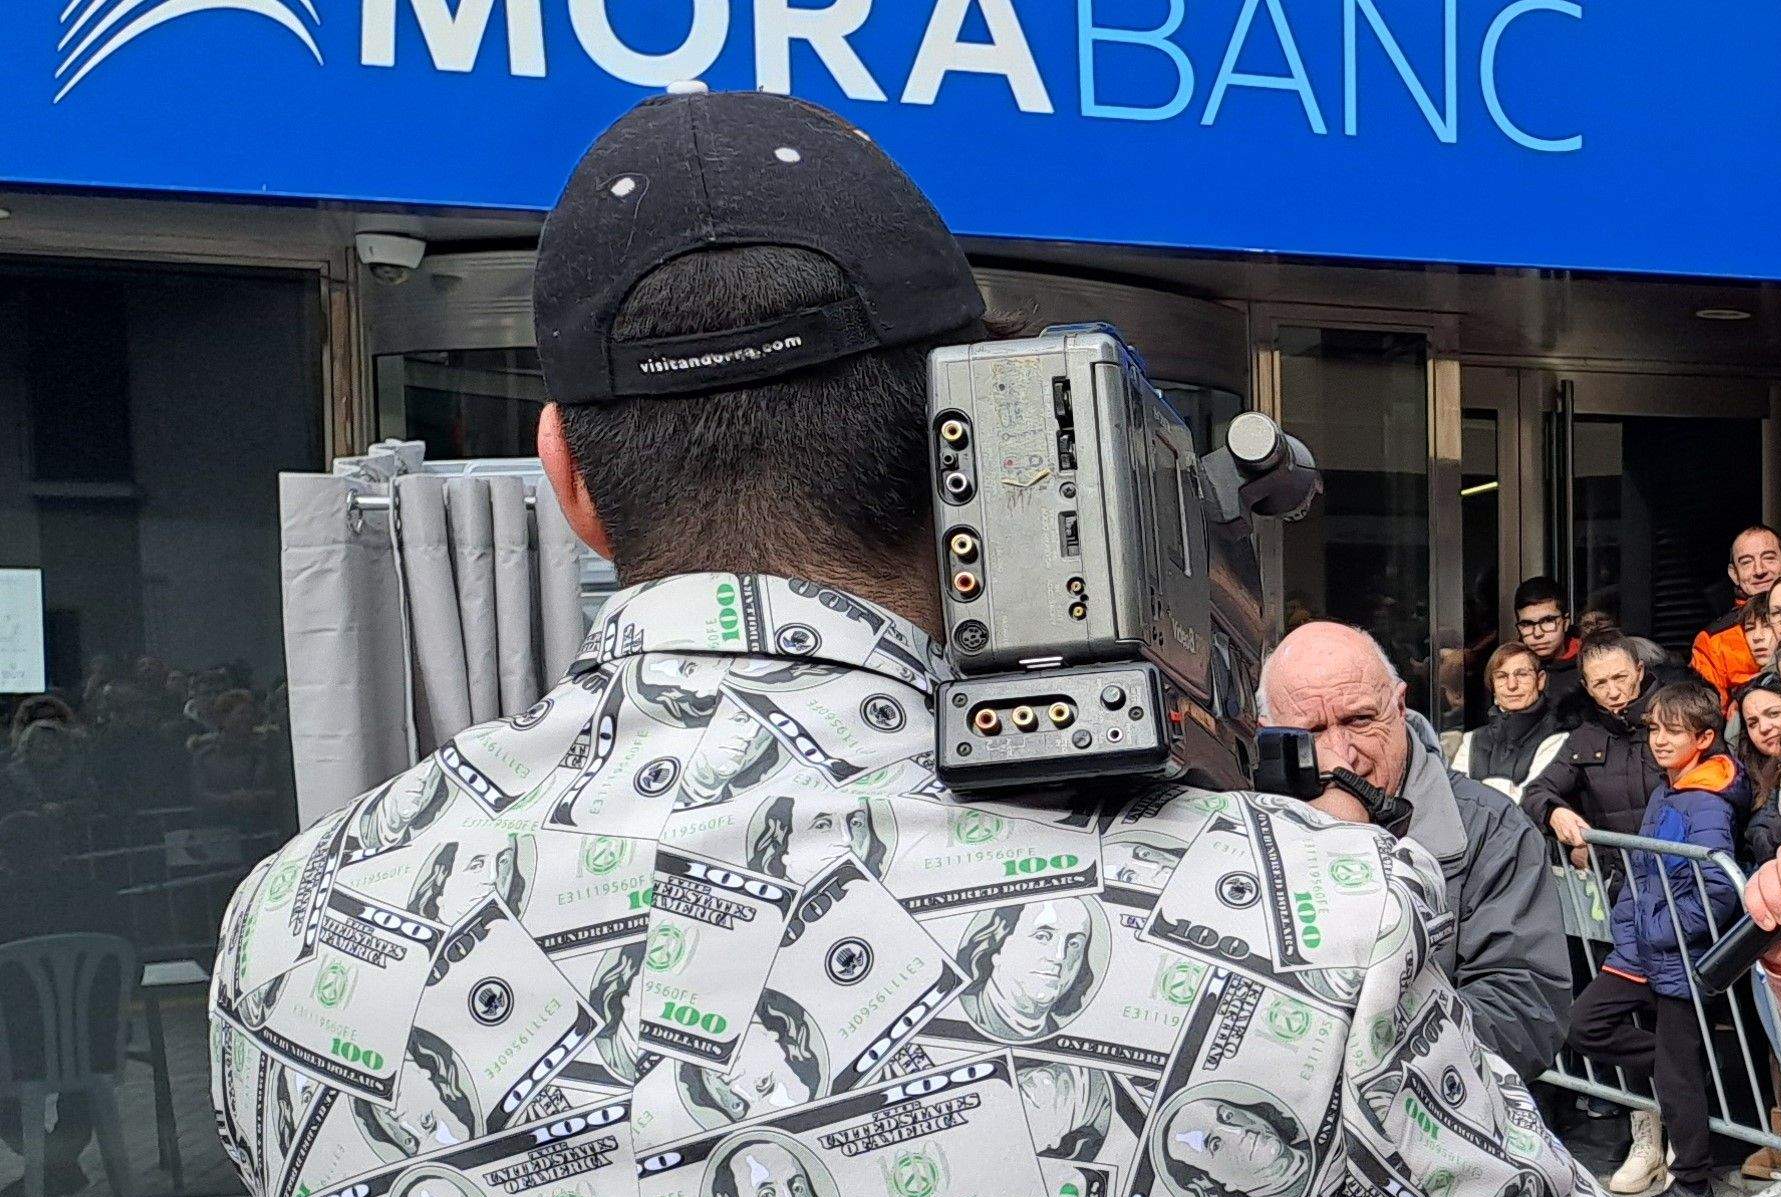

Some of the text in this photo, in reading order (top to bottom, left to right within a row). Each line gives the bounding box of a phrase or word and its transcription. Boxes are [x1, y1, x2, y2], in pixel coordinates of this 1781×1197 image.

[716, 583, 739, 640] 100
[787, 574, 864, 622] 100
[924, 845, 1036, 869] E31119560FE
[1004, 853, 1078, 875] 100
[685, 859, 786, 903] 100
[908, 872, 1086, 910] HUNDRED DOLLARS
[1261, 834, 1282, 889] HUNDRED
[1273, 890, 1296, 956] DOLLARS
[358, 905, 435, 942] 100
[681, 889, 756, 922] STATES
[1293, 892, 1322, 950] 100
[418, 920, 493, 985] 100
[543, 920, 623, 947] HUNDRED
[1171, 918, 1251, 961] 100
[659, 1001, 728, 1034] 100
[837, 956, 924, 1040] E31119560FE
[650, 1026, 723, 1055] DOLLARS
[850, 987, 945, 1073] 100
[1057, 1036, 1095, 1053] ONE
[329, 1038, 386, 1072] 100
[494, 1028, 586, 1113] 100
[884, 1062, 998, 1102] 100
[531, 1103, 628, 1144] 100
[819, 1093, 981, 1150] UNITED STATES
[839, 1111, 967, 1157] OF AMERICA
[483, 1135, 619, 1187] UNITED STATES
[504, 1153, 612, 1195] OF AMERICA
